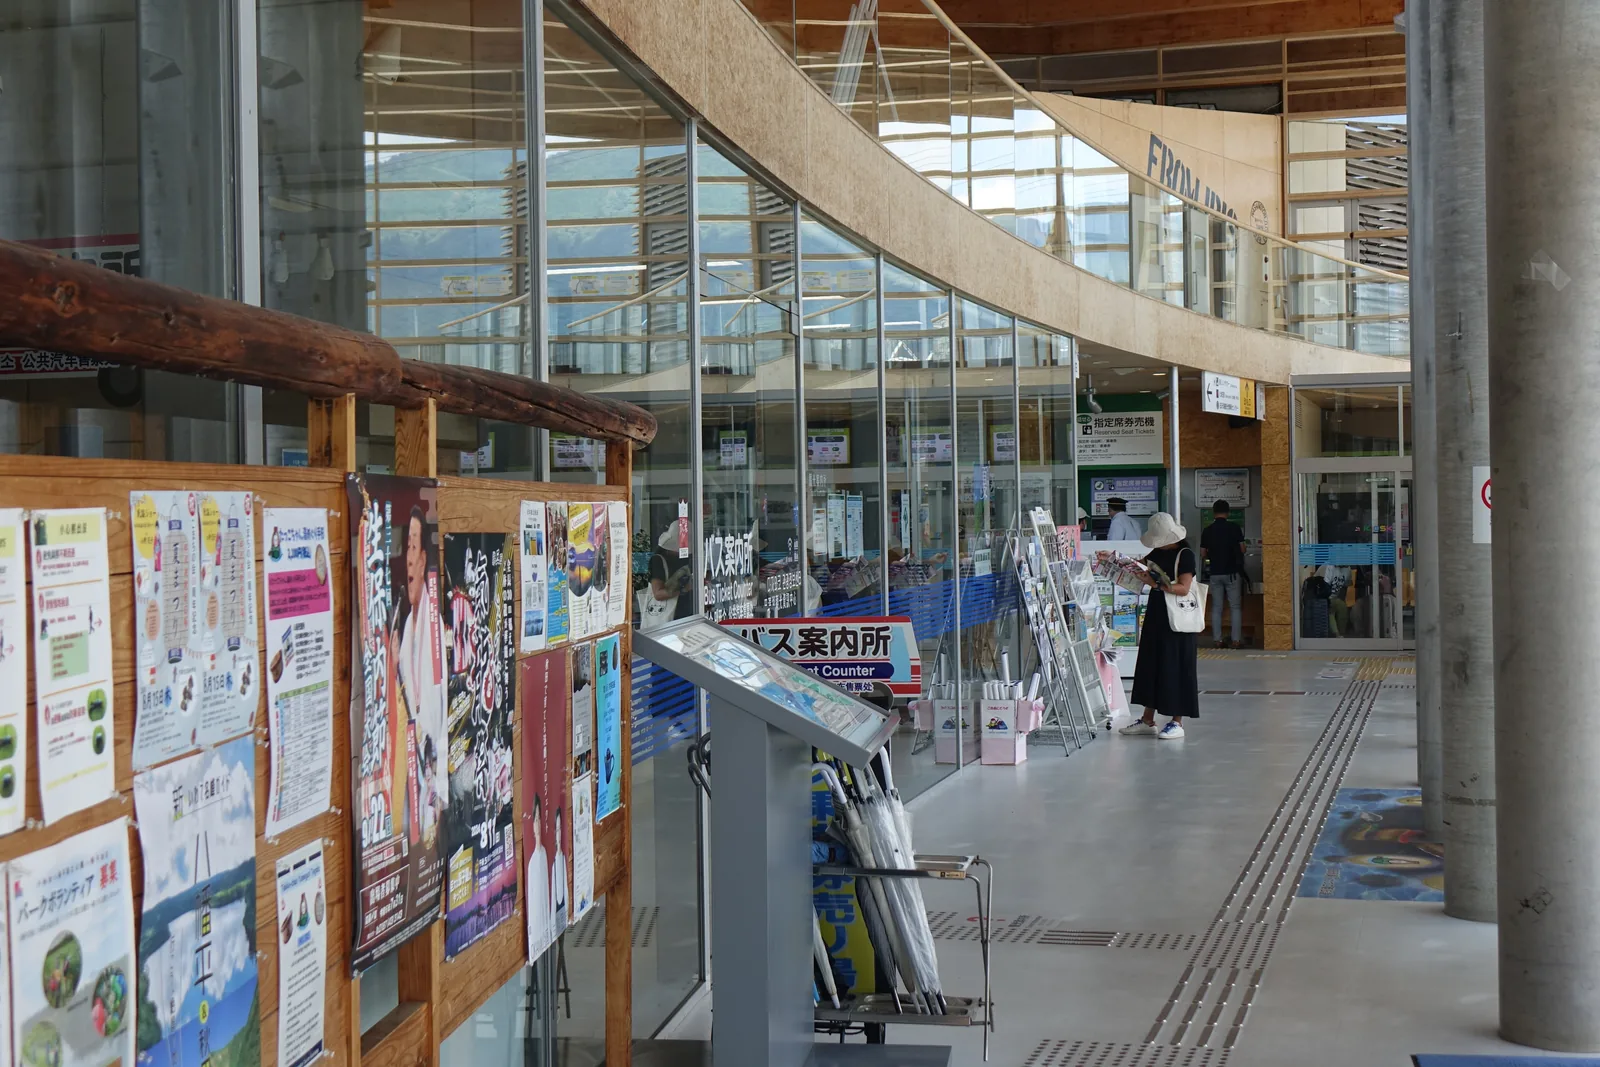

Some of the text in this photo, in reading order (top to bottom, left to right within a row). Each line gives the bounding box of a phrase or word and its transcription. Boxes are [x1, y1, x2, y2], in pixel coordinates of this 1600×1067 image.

[1094, 416, 1155, 428] 指定席券売機
[703, 532, 754, 578] バス案内所
[703, 580, 754, 606] Bus Ticket Counter
[741, 625, 891, 659] バス案内所
[821, 665, 876, 677] Counter
[17, 873, 95, 924] パークボランティア
[100, 858, 118, 890] 募集
